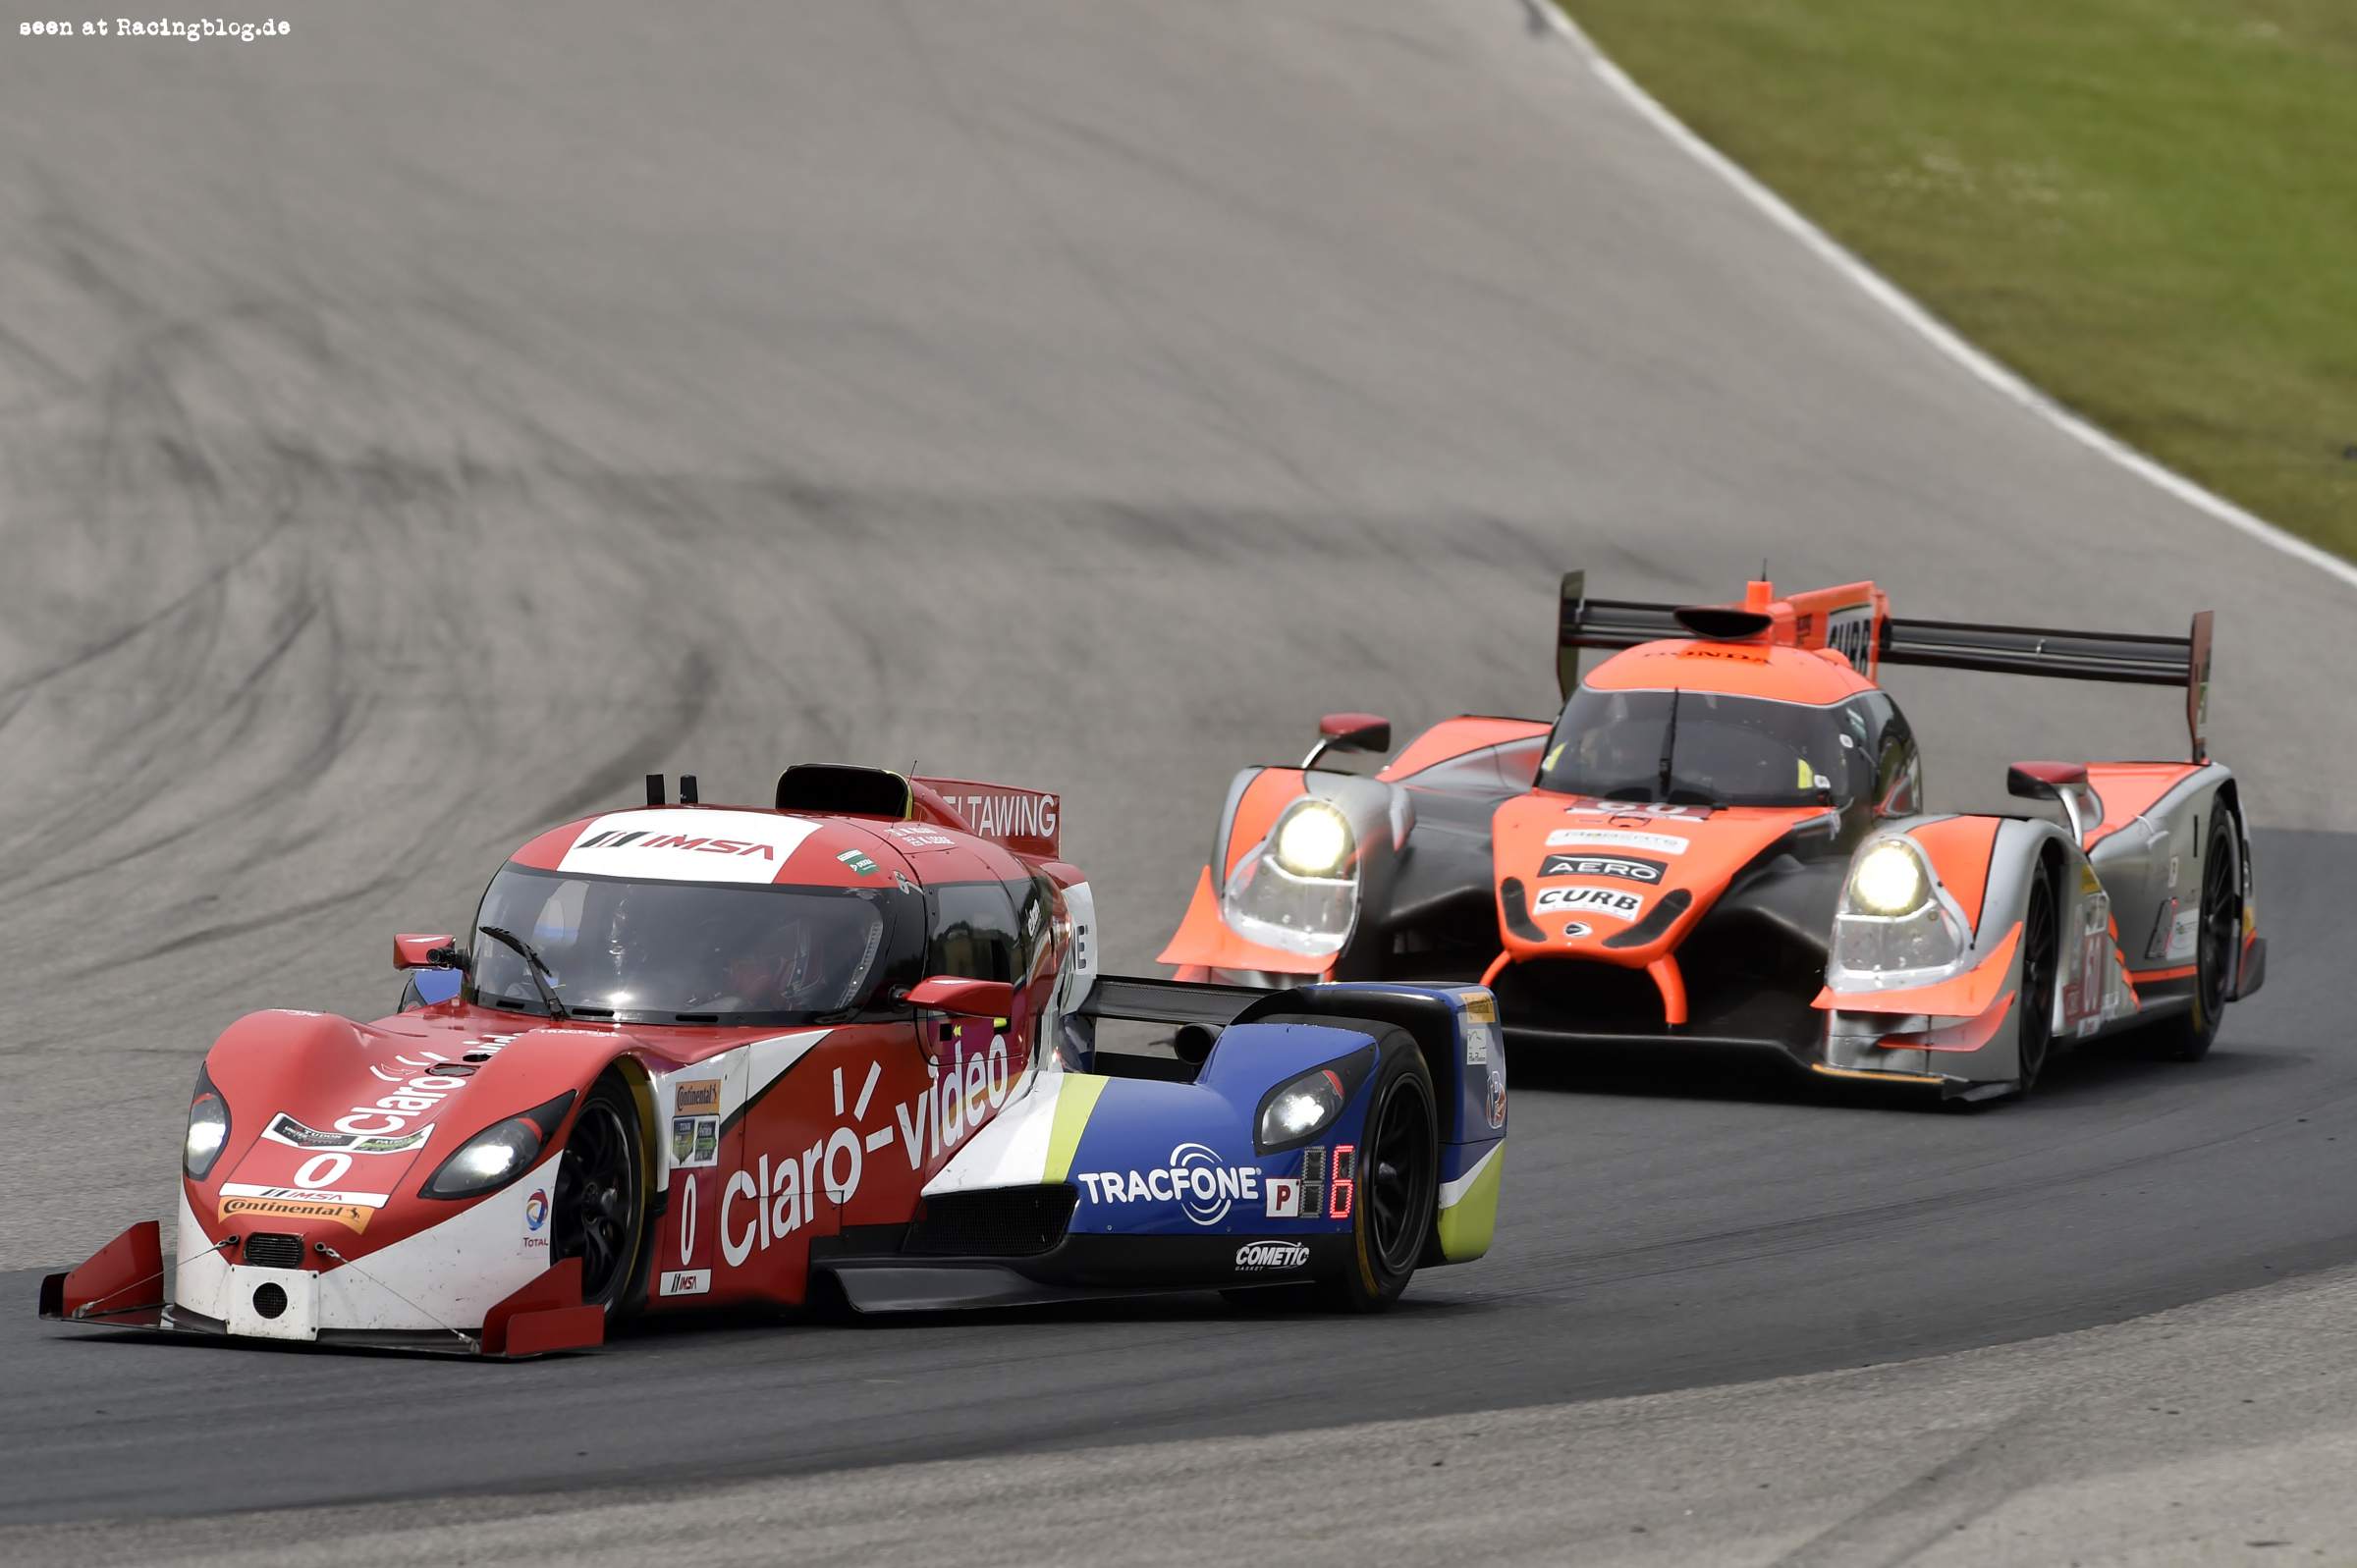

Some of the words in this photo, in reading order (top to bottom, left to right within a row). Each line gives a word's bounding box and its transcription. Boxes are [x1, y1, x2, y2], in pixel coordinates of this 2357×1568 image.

[638, 834, 774, 861] IMSA
[1549, 862, 1658, 880] AERO
[1539, 890, 1638, 910] CURB
[334, 1075, 466, 1134] Claro
[677, 1084, 712, 1111] Continental
[294, 1153, 353, 1189] 0
[288, 1191, 343, 1201] IMSA
[1078, 1167, 1259, 1204] TRACFONE
[1276, 1184, 1291, 1211] P
[224, 1199, 343, 1216] Continental
[681, 1173, 696, 1266] 0
[1235, 1243, 1309, 1266] COMETIC
[678, 1275, 697, 1290] IMSA
